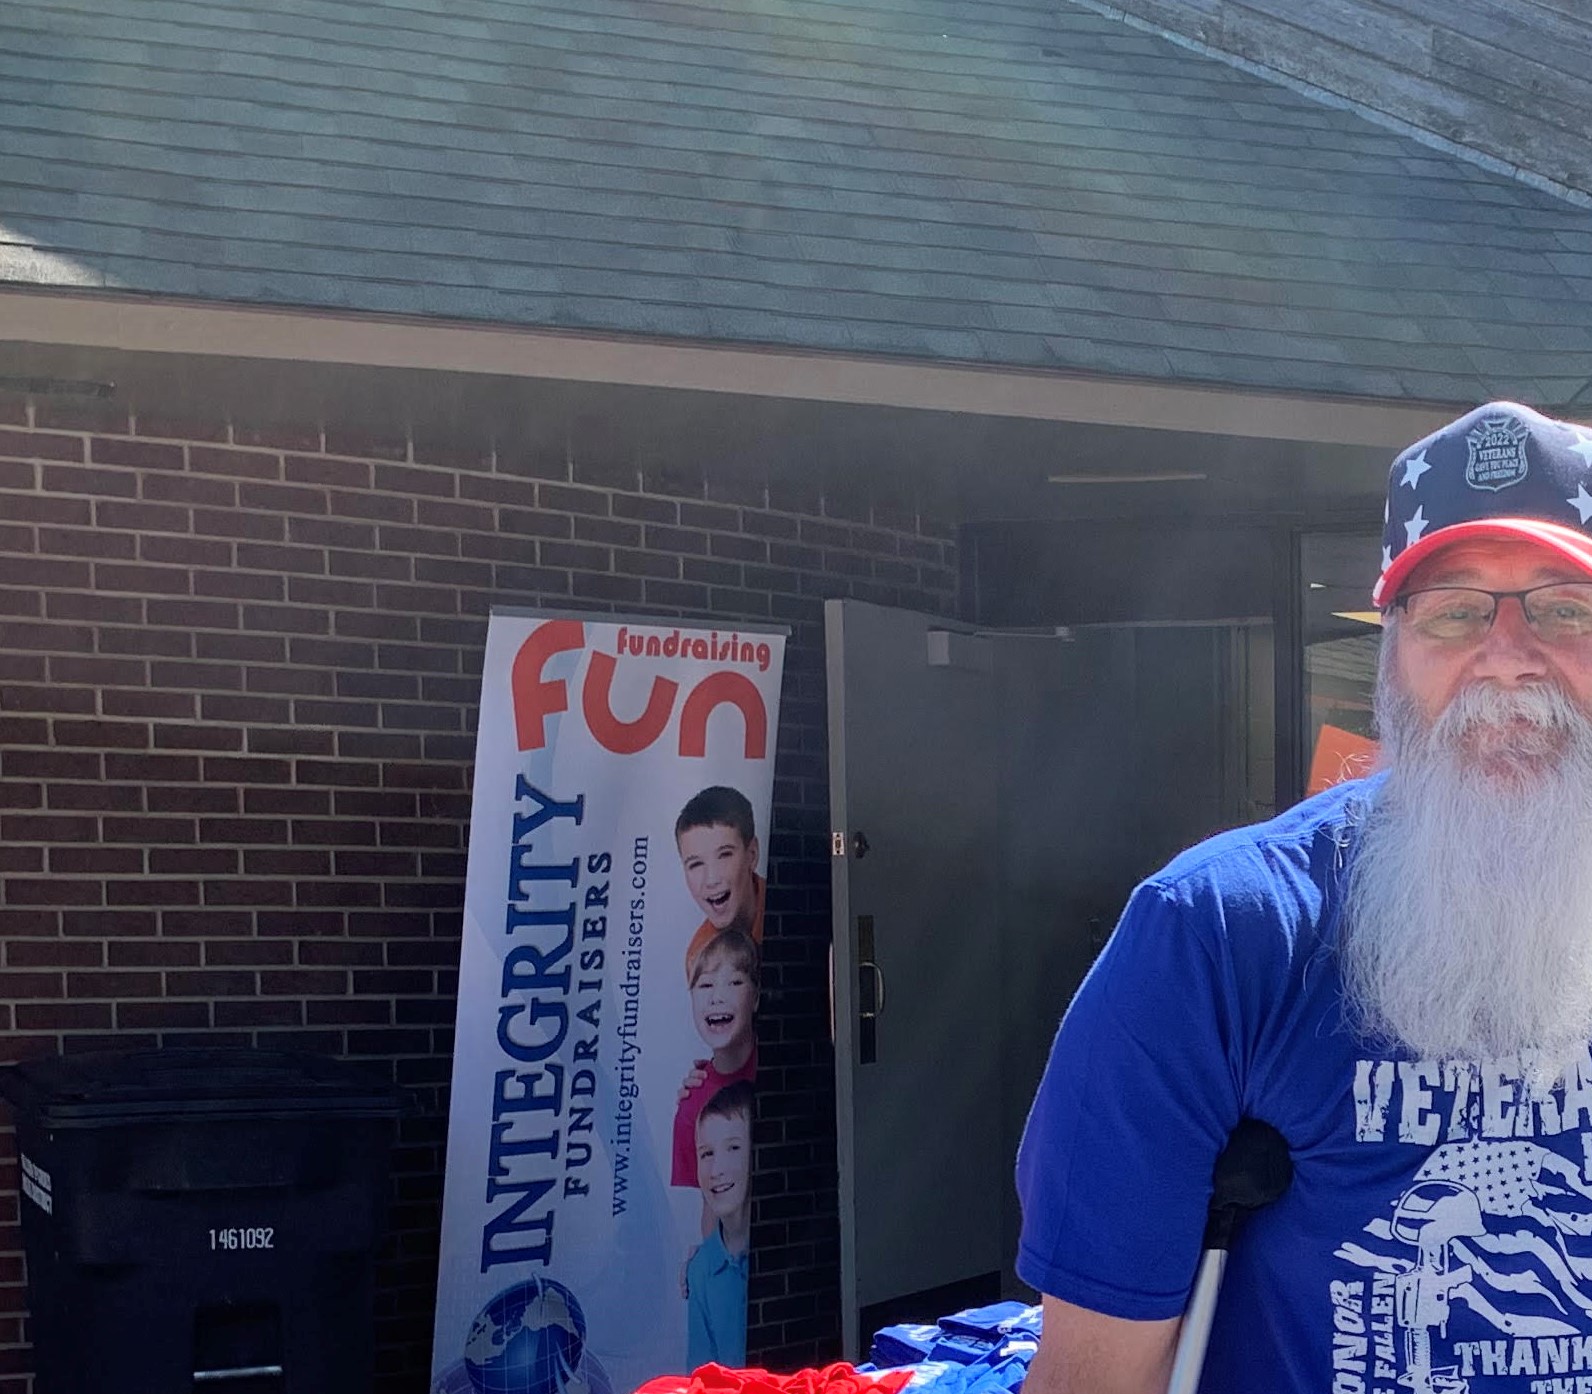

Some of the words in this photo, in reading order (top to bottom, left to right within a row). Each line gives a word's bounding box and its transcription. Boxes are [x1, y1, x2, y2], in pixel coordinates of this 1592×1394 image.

[1479, 447, 1516, 460] VETERANS
[1485, 433, 1509, 447] 2022
[617, 626, 771, 673] fundraising
[481, 773, 585, 1273] INTEGRITY
[563, 851, 612, 1198] FUNDRAISERS
[612, 835, 649, 1218] www.integrityfundraisers.com
[208, 1227, 274, 1250] 1461092
[1373, 1272, 1397, 1381] FALLEN
